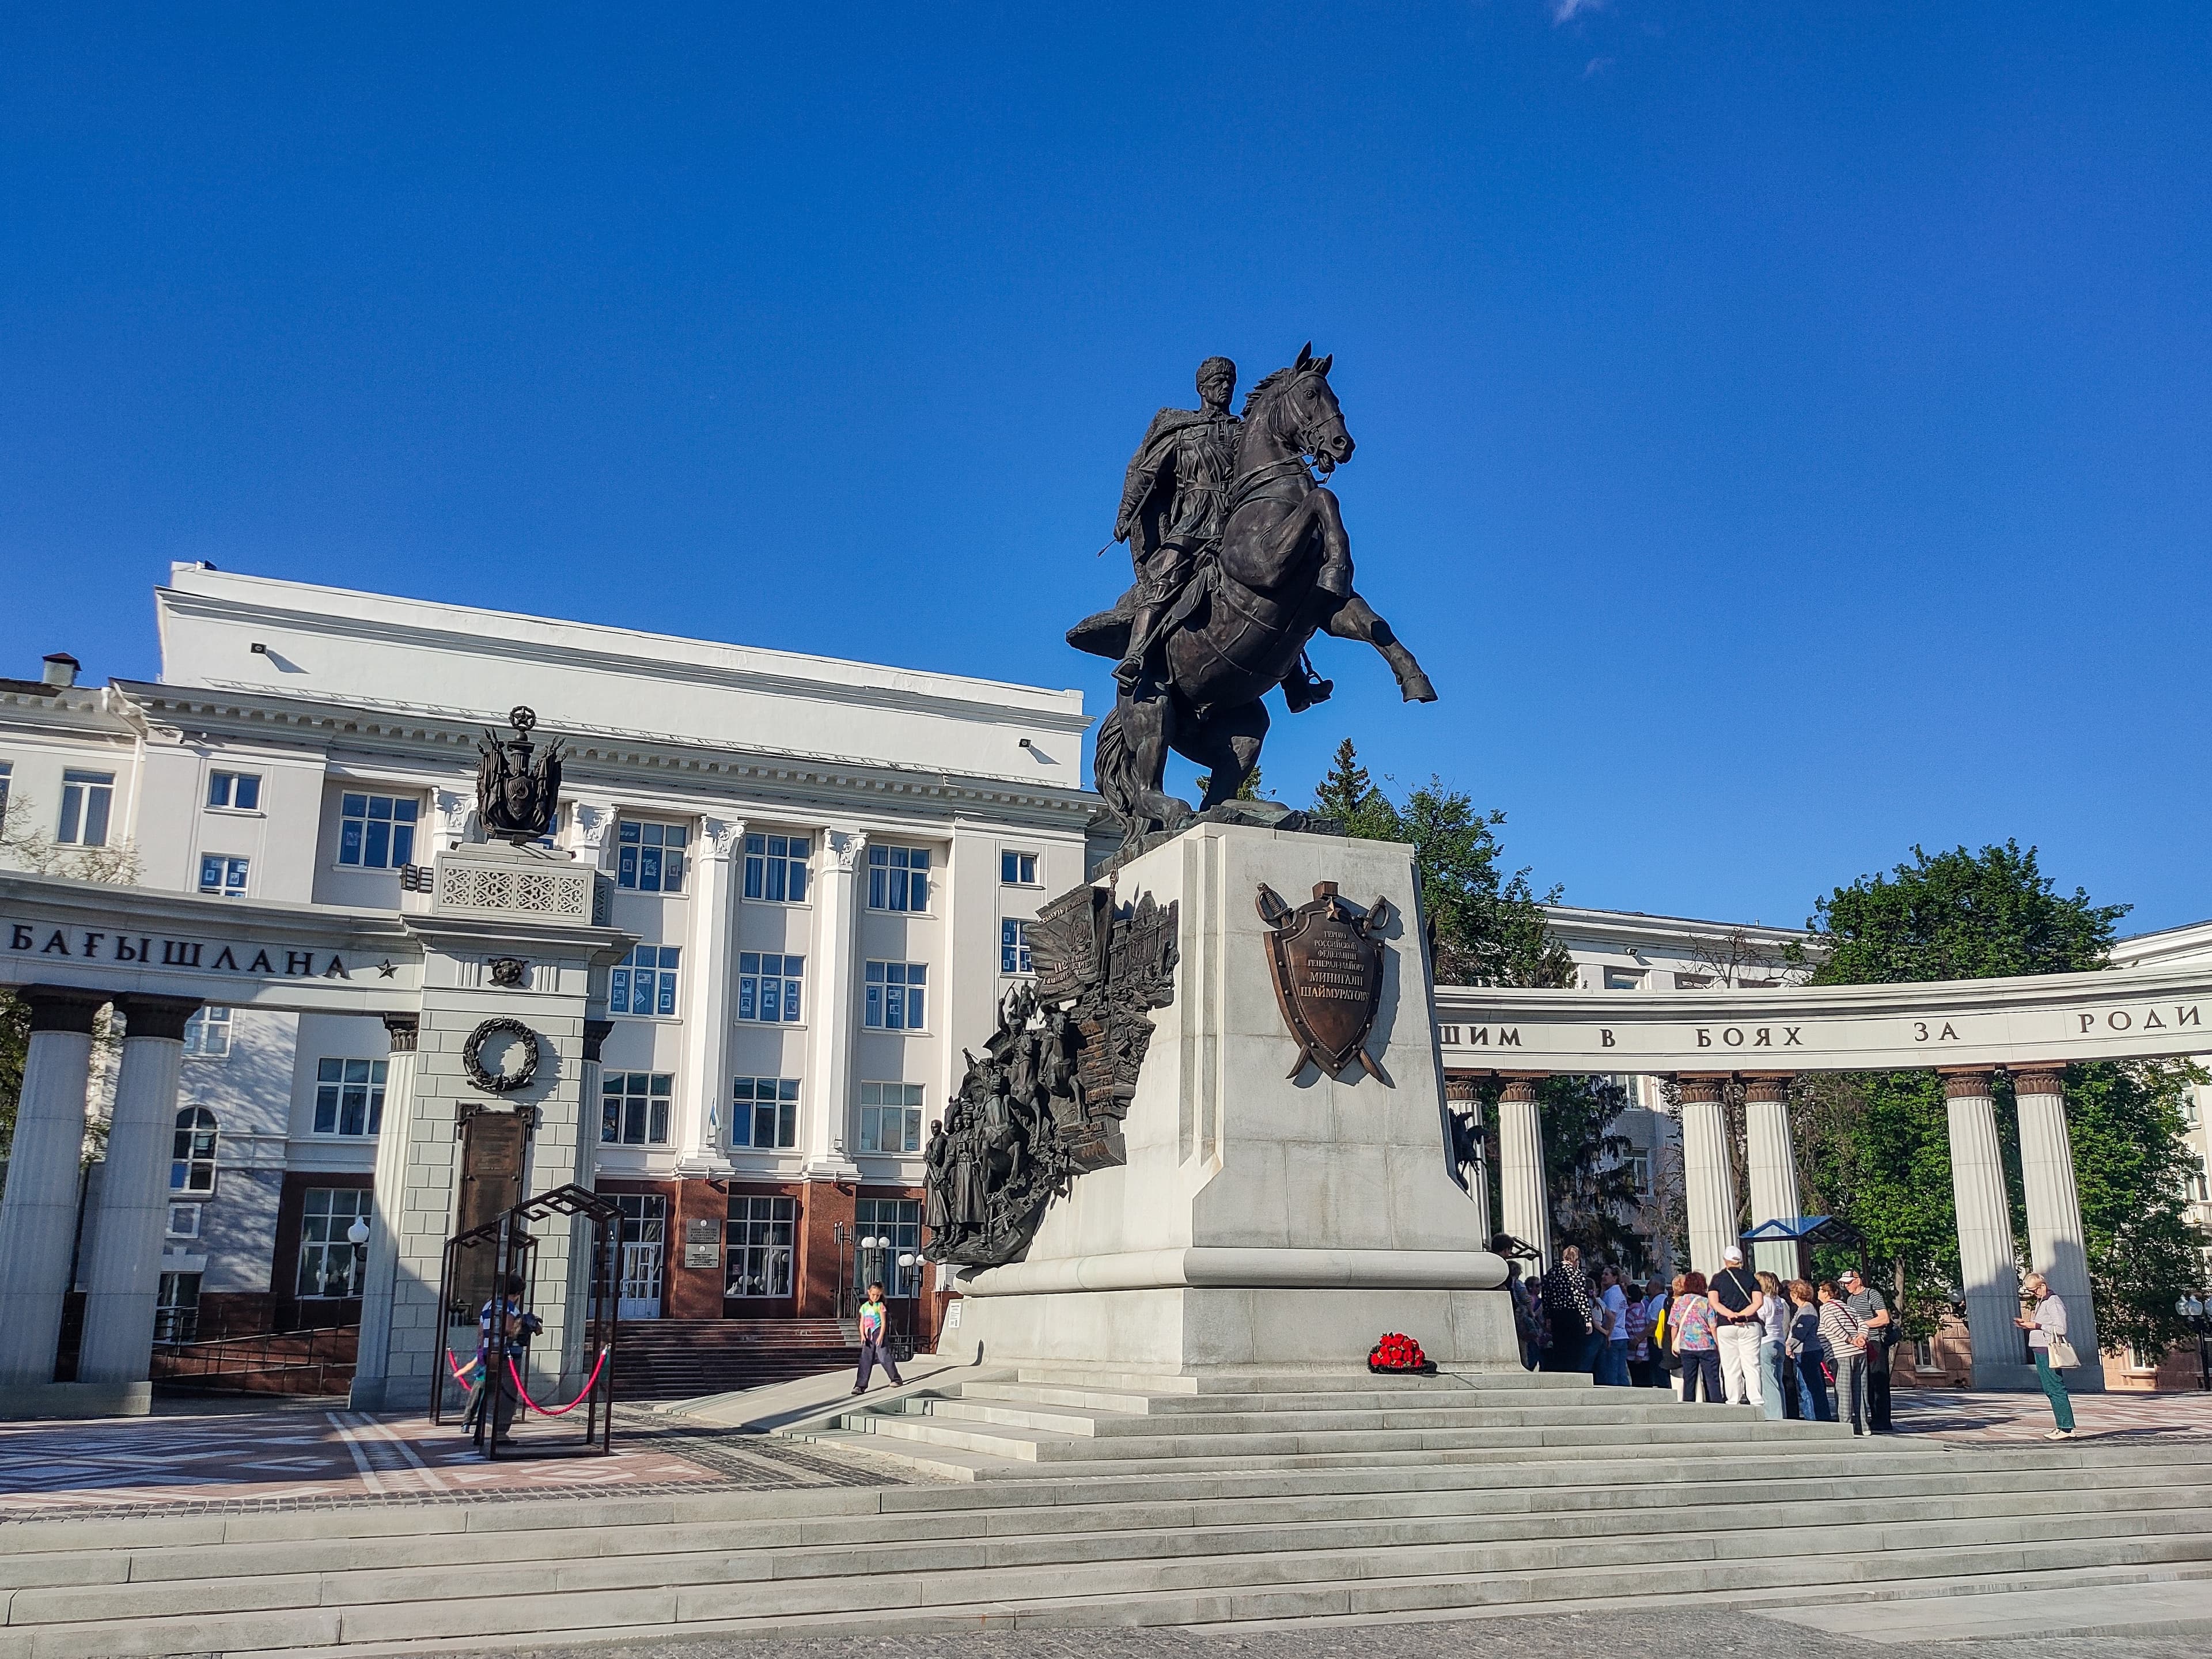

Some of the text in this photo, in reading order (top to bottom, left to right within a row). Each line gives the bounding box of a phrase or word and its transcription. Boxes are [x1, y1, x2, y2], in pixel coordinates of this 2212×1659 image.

[1324, 930, 1347, 939] ГЕРОЮ
[9, 923, 354, 980] БАҒЫШЛАНА
[1314, 939, 1358, 950] РОССИЙСКОЙ
[1317, 949, 1357, 960] ФЕДЕРАЦИИ
[1309, 971, 1363, 986] МИНИГАЛИ
[1300, 984, 1370, 1001] ШАЙМУРАТОВУ
[1599, 1028, 1616, 1047] В
[1696, 1027, 1804, 1048] БОЯХ
[1914, 1021, 1961, 1042] ЗА
[2078, 1005, 2202, 1033] РОДИ
